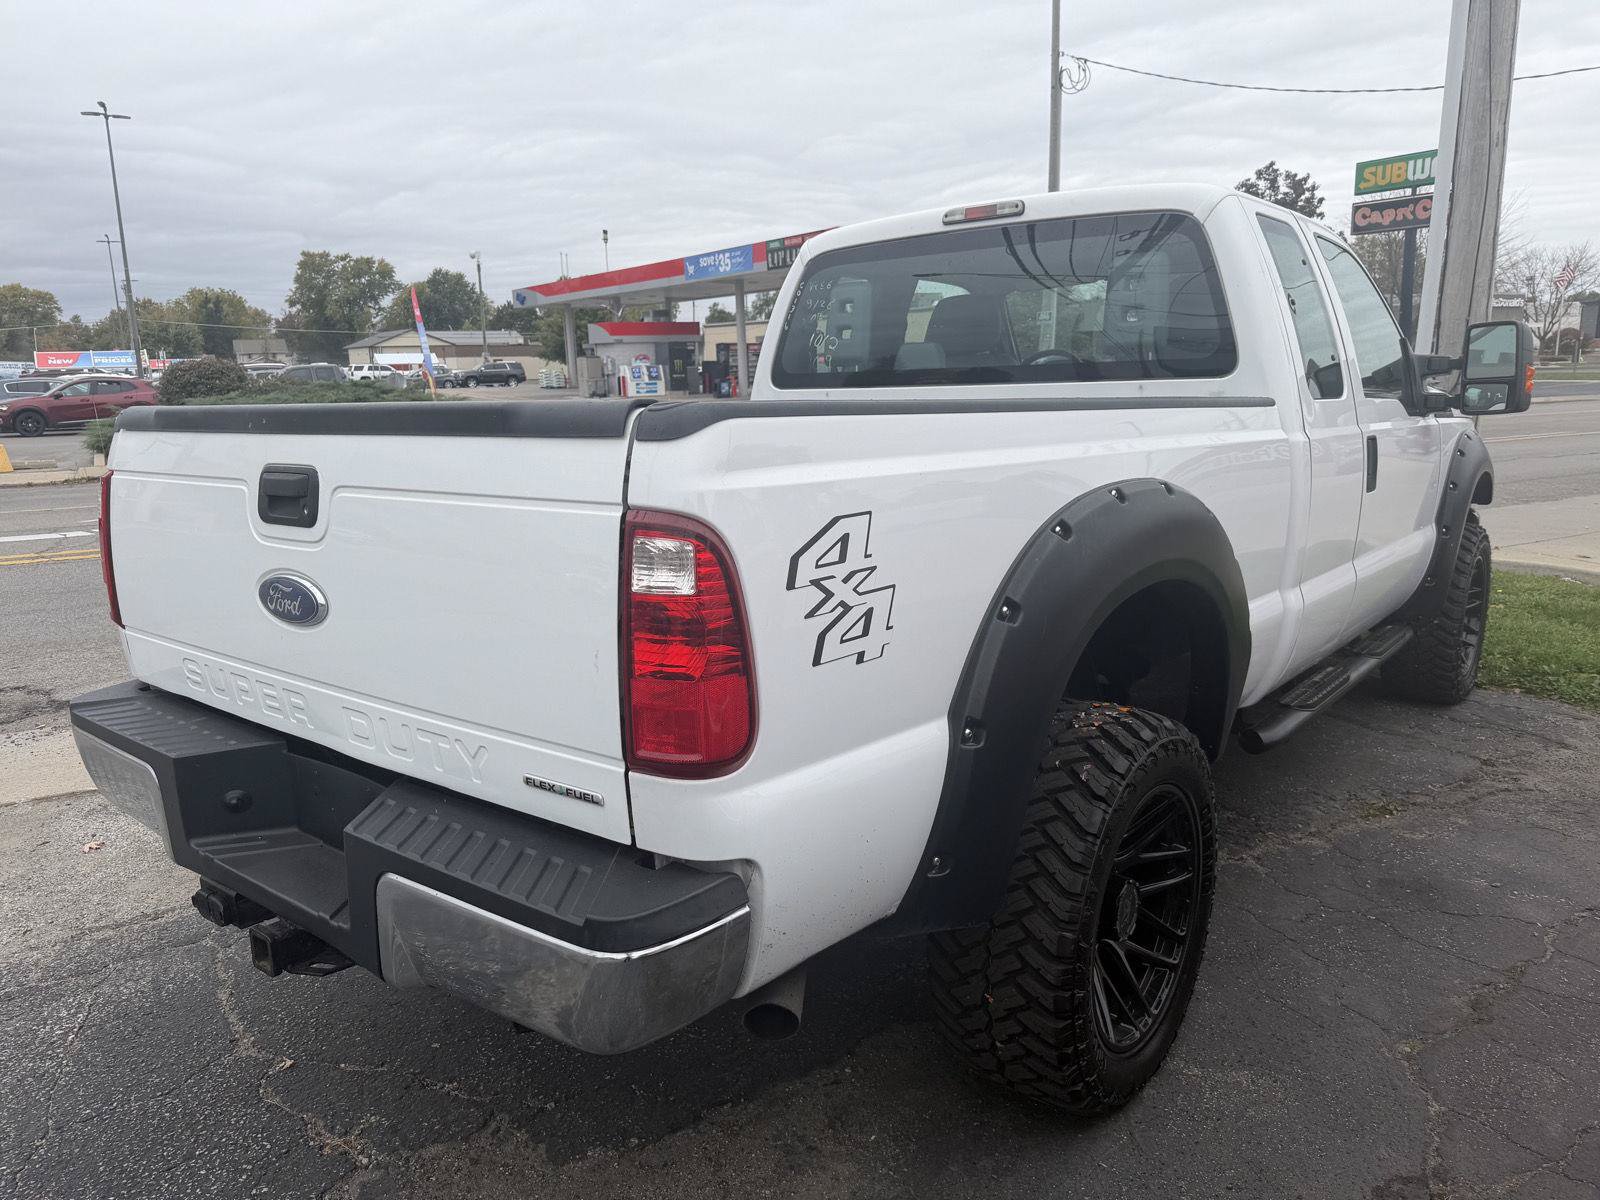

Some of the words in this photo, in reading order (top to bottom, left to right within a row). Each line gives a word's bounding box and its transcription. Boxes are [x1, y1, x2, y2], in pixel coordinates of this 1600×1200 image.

[267, 582, 302, 616] Ford
[182, 657, 314, 729] SUPER
[341, 705, 490, 784] DUTY
[525, 776, 556, 793] FLEX
[565, 787, 600, 805] FUEL
